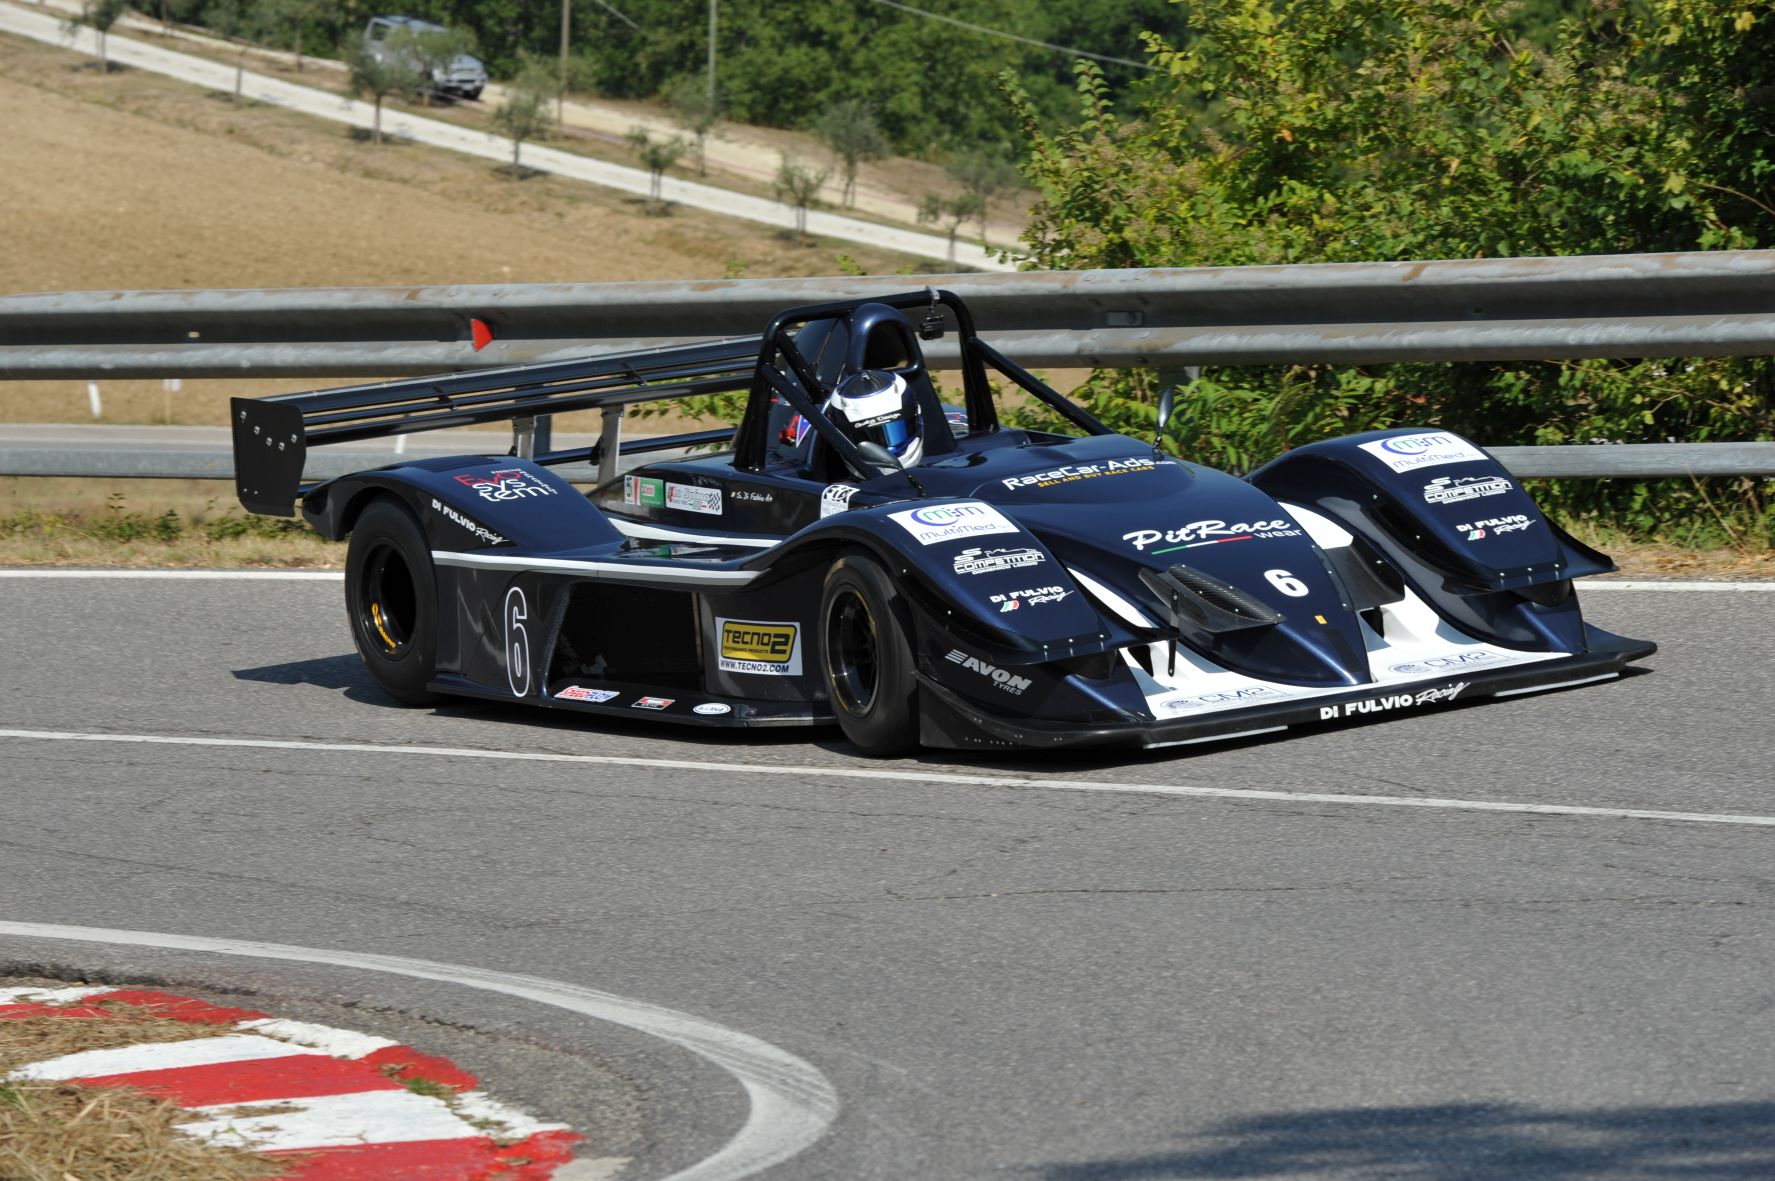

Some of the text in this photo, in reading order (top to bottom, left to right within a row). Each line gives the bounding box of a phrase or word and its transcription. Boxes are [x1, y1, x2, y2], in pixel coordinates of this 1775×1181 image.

[1037, 479, 1060, 488] SELL
[1062, 475, 1082, 483] AND
[1424, 481, 1513, 503] COMPETITION
[432, 498, 442, 512] DI
[443, 506, 476, 532] FULVIO
[1456, 515, 1528, 532] DI FULVIO
[1254, 528, 1303, 539] wear
[953, 553, 1045, 575] COMPETITION
[1263, 568, 1309, 597] 6
[989, 586, 1065, 603] DI FULVIO
[504, 586, 530, 698] 6
[720, 660, 790, 674] WWW.TECNO2.COM
[962, 656, 1033, 691] AVON
[993, 680, 1024, 696] TYRES
[1319, 680, 1472, 721] DI FULVIO Racing
